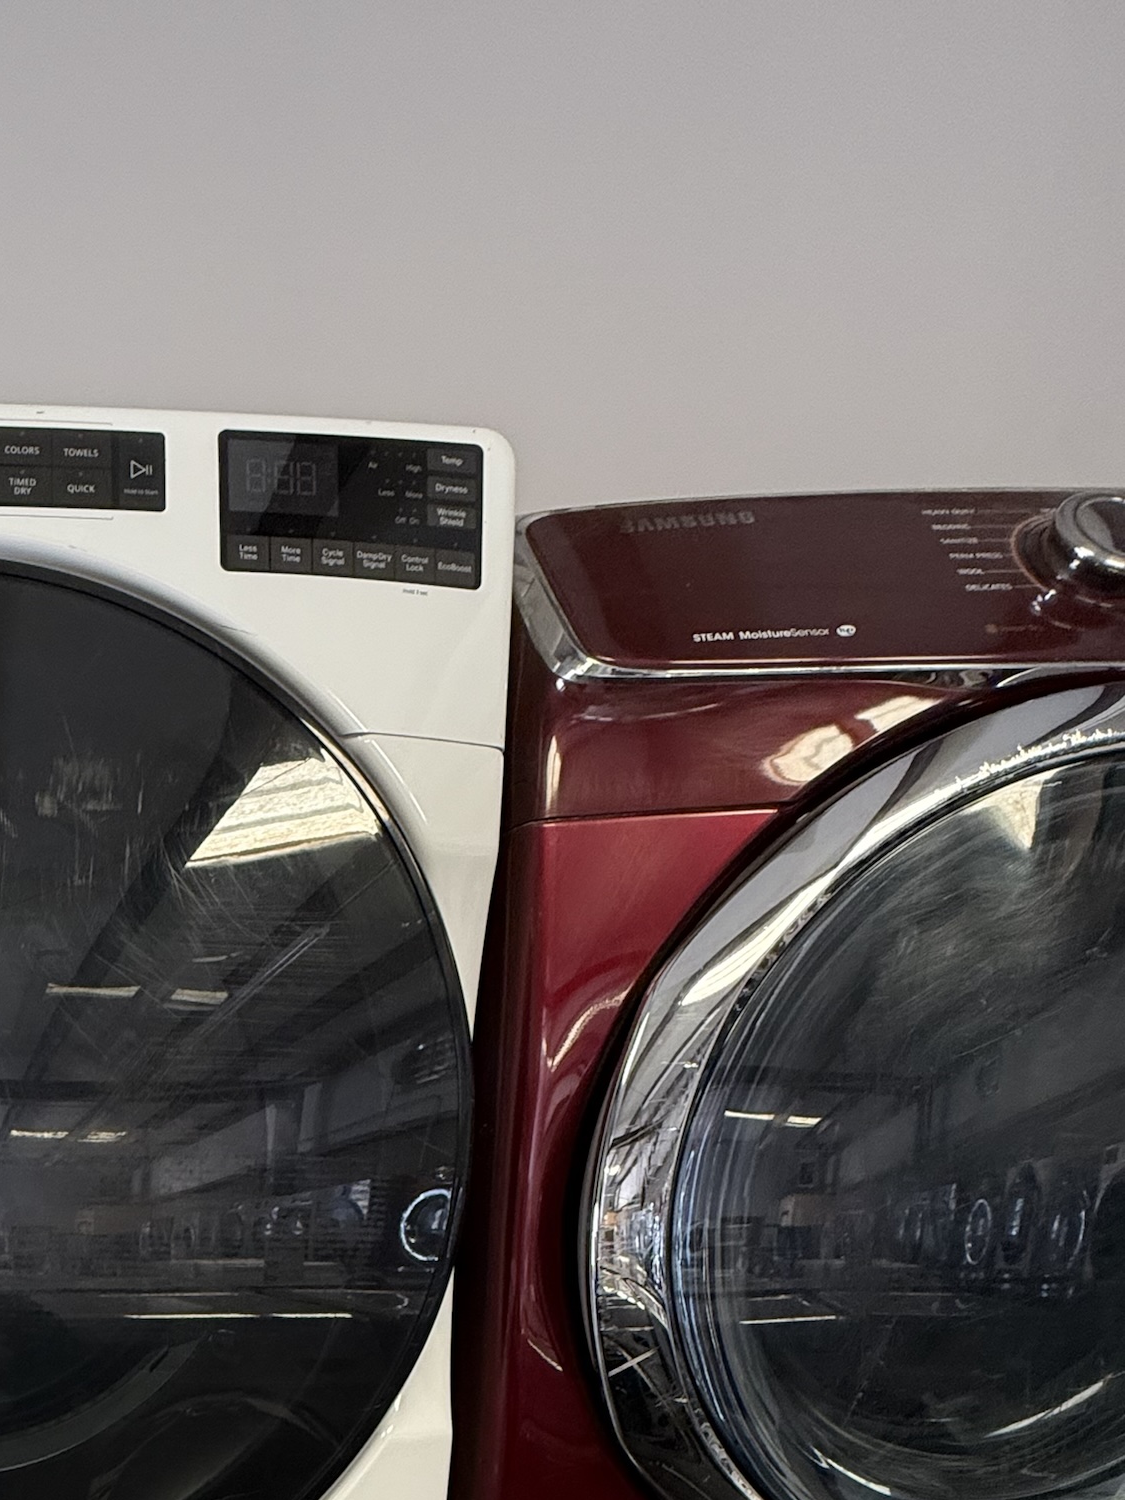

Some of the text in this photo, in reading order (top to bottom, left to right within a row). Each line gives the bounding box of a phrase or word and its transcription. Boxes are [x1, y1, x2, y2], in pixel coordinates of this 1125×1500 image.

[5, 446, 40, 455] COLORS
[64, 448, 98, 457] TOWELS
[441, 455, 464, 467] Temp
[9, 478, 36, 487] TIMED
[14, 487, 32, 495] DRY
[67, 484, 95, 493] QUICK
[435, 483, 468, 495] Dryness
[437, 508, 466, 518] Wrinkle
[439, 516, 464, 527] Shield
[620, 511, 756, 533] SAMSUNG
[239, 544, 257, 552] Less
[281, 546, 301, 555] More
[239, 552, 258, 560] Time
[282, 554, 301, 563] Time
[322, 549, 343, 559] Cycle
[321, 557, 345, 566] Signal
[401, 555, 428, 564] Control
[406, 563, 424, 572] Lock
[693, 632, 734, 642] STEAM
